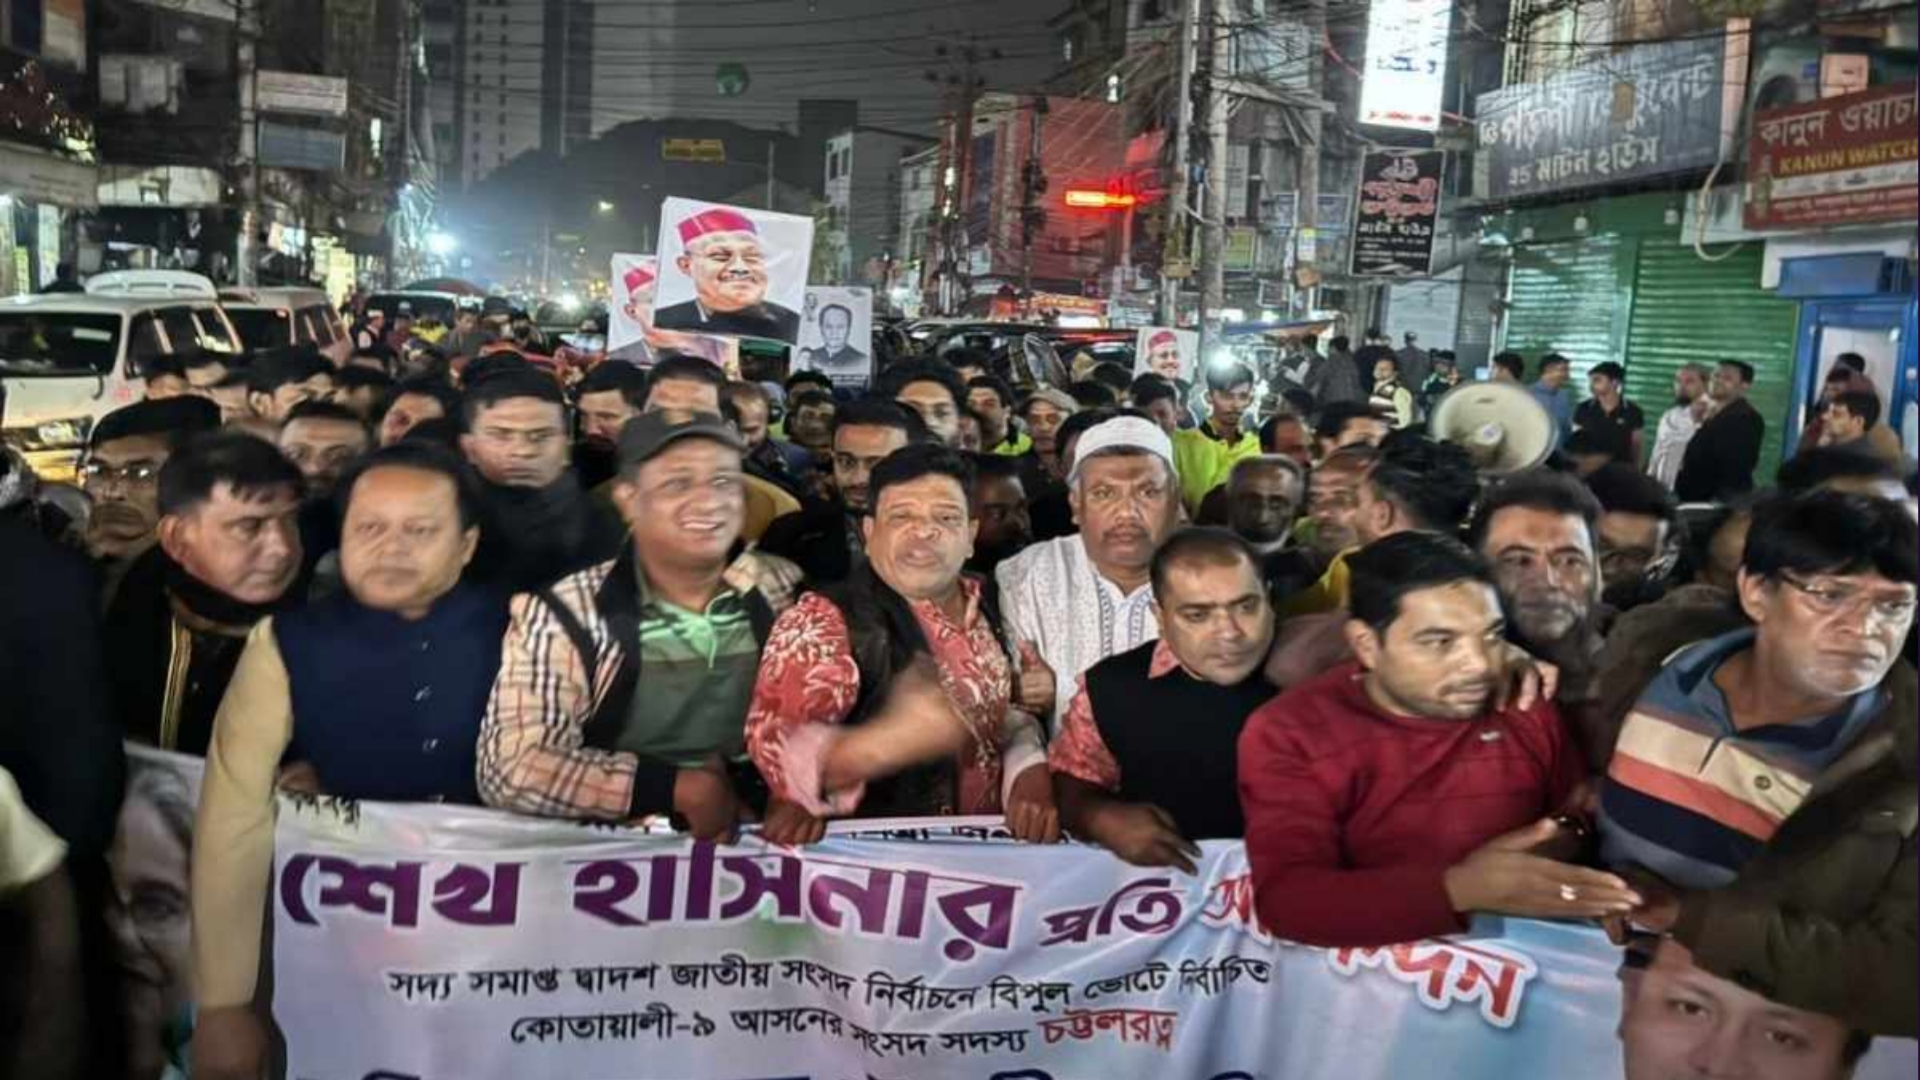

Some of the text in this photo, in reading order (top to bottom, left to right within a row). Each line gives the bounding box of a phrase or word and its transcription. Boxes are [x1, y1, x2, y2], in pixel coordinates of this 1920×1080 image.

[1759, 109, 1830, 146] কানুন
[1595, 134, 1660, 176] হাউস
[1780, 149, 1846, 174] KANUN
[281, 853, 525, 928] শেখ
[566, 840, 1023, 961] হাসিনার
[1038, 878, 1187, 947] প্রতি
[387, 970, 453, 1000] সদ্য
[469, 965, 562, 996] সমাপ্ত
[574, 961, 658, 993] দ্বাদশ
[668, 953, 772, 988] জাতীয়
[780, 960, 857, 999] সংসদ
[864, 971, 980, 1010] নির্বাচনে
[988, 975, 1073, 1012] বিপুল
[1083, 962, 1171, 999] ভোটে
[731, 1007, 846, 1036] আসনের
[850, 1022, 931, 1057] সংসদ
[941, 1027, 1029, 1054] সদস্য
